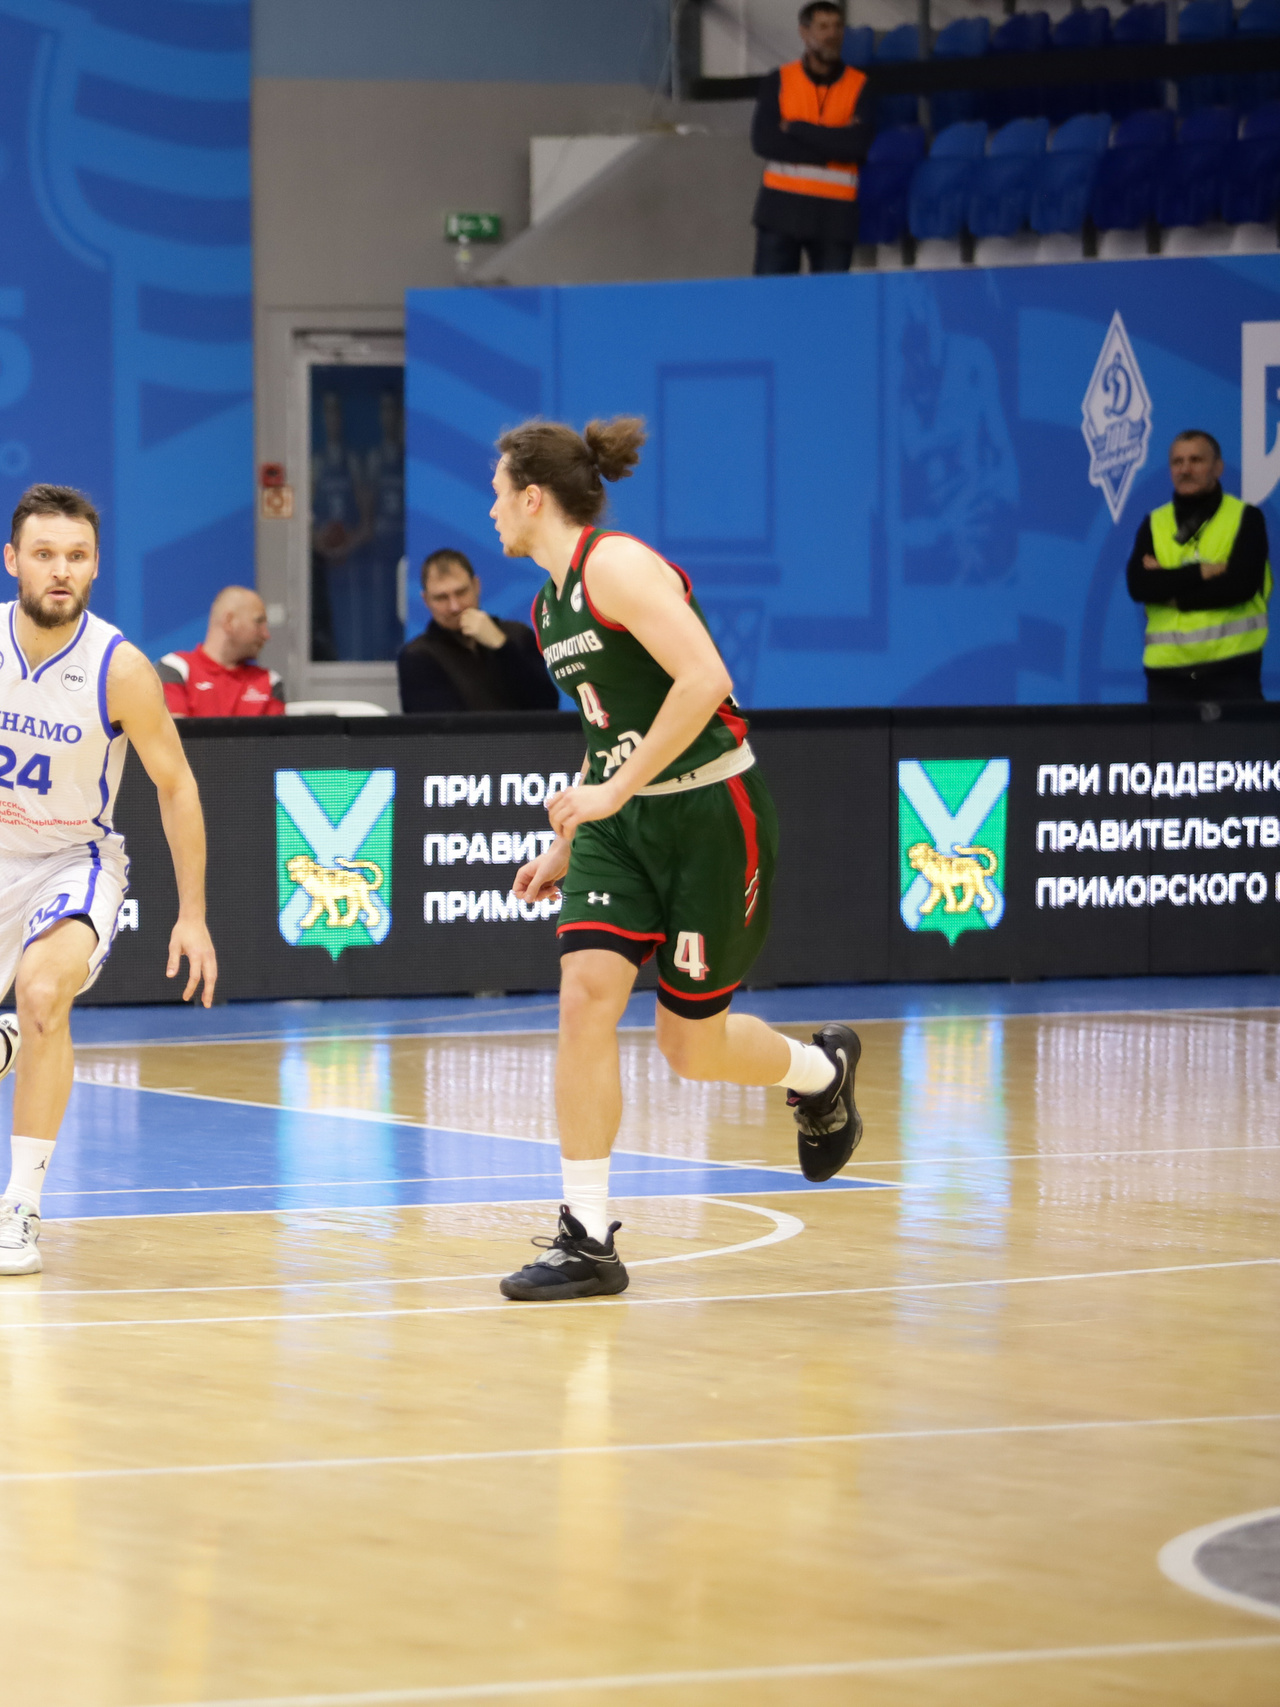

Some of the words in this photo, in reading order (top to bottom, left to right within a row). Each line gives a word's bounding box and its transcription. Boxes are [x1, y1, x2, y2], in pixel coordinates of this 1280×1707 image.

[543, 629, 603, 668] КОМОТИВ
[65, 673, 84, 683] РФБ
[576, 682, 610, 730] 4
[423, 774, 491, 808] ПРИ
[500, 772, 583, 811] ПОД
[1036, 763, 1102, 797] ПРИ
[1035, 871, 1268, 910] ПРИМОРСКОГО
[673, 931, 710, 981] 4
